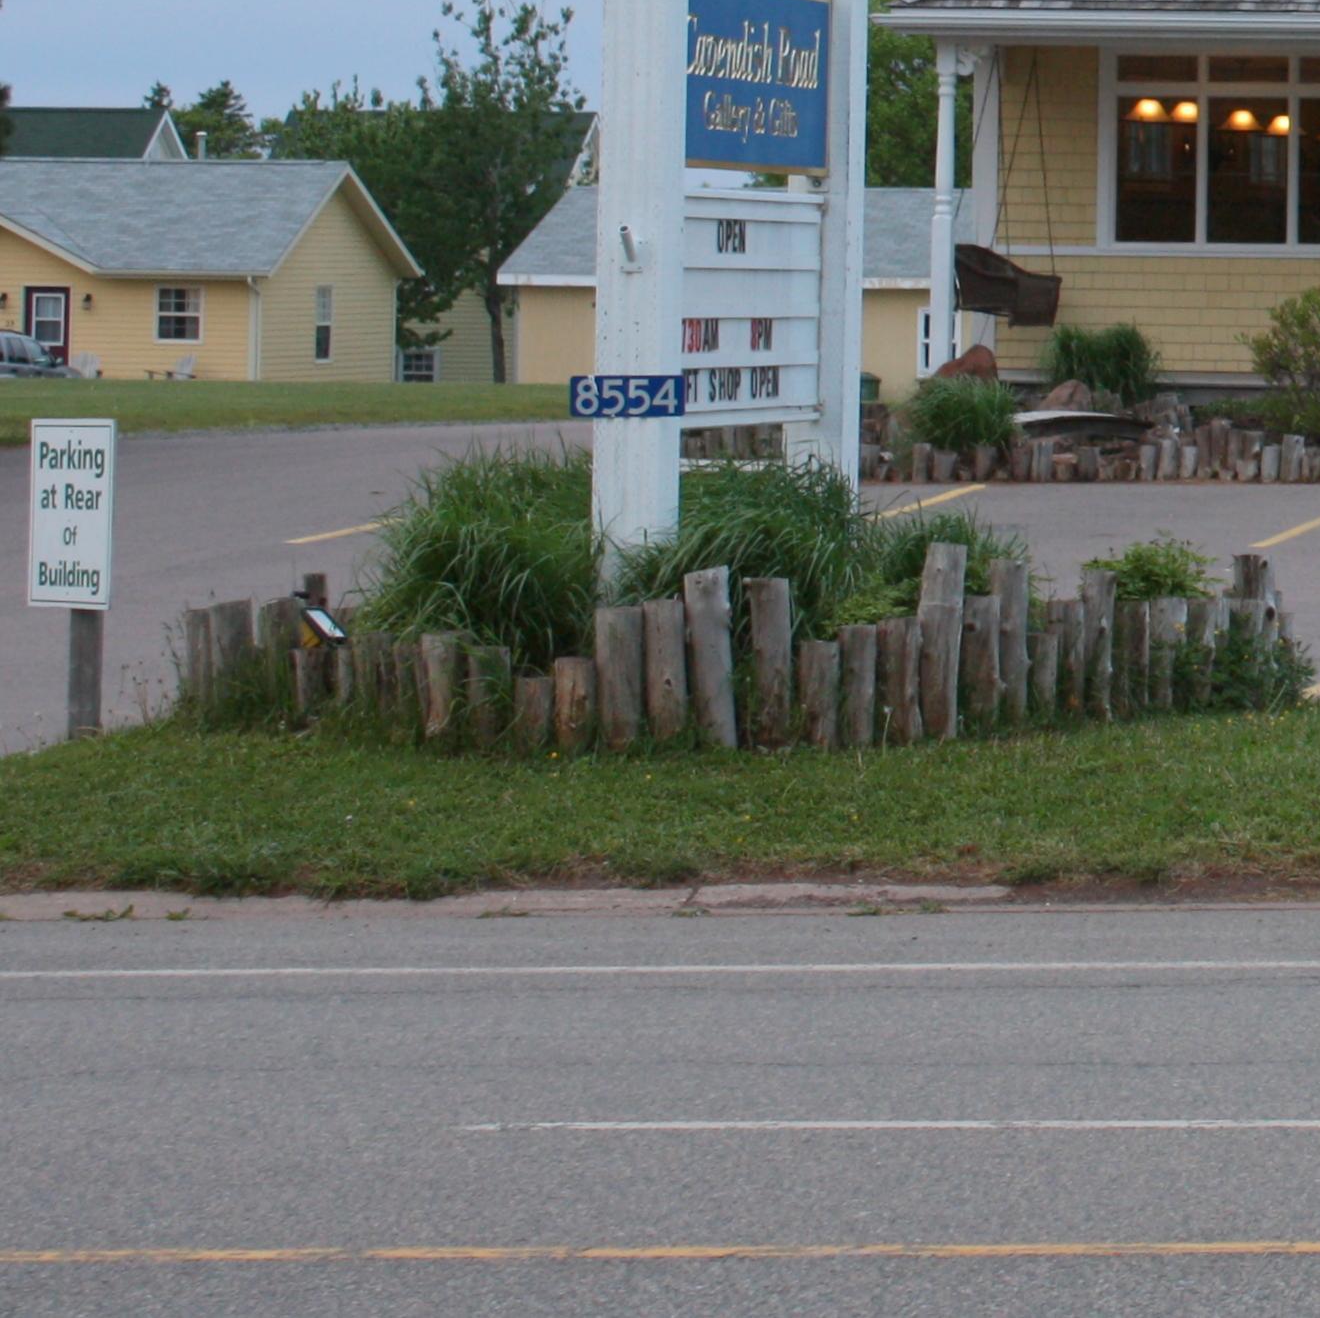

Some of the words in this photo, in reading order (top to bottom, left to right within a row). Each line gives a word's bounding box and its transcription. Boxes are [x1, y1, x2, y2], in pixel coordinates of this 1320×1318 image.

[776, 26, 821, 89] Road
[704, 90, 750, 144] Gallery
[754, 97, 766, 134] &
[769, 98, 798, 138] Gifts
[717, 219, 746, 254] OPEN
[751, 318, 772, 351] 8PM
[575, 379, 678, 416] 8554
[709, 368, 741, 402] SHOP
[751, 366, 779, 398] OPEN
[39, 440, 105, 478] Parking
[41, 484, 57, 510] at
[65, 483, 102, 510] Rear
[38, 560, 100, 596] Building
